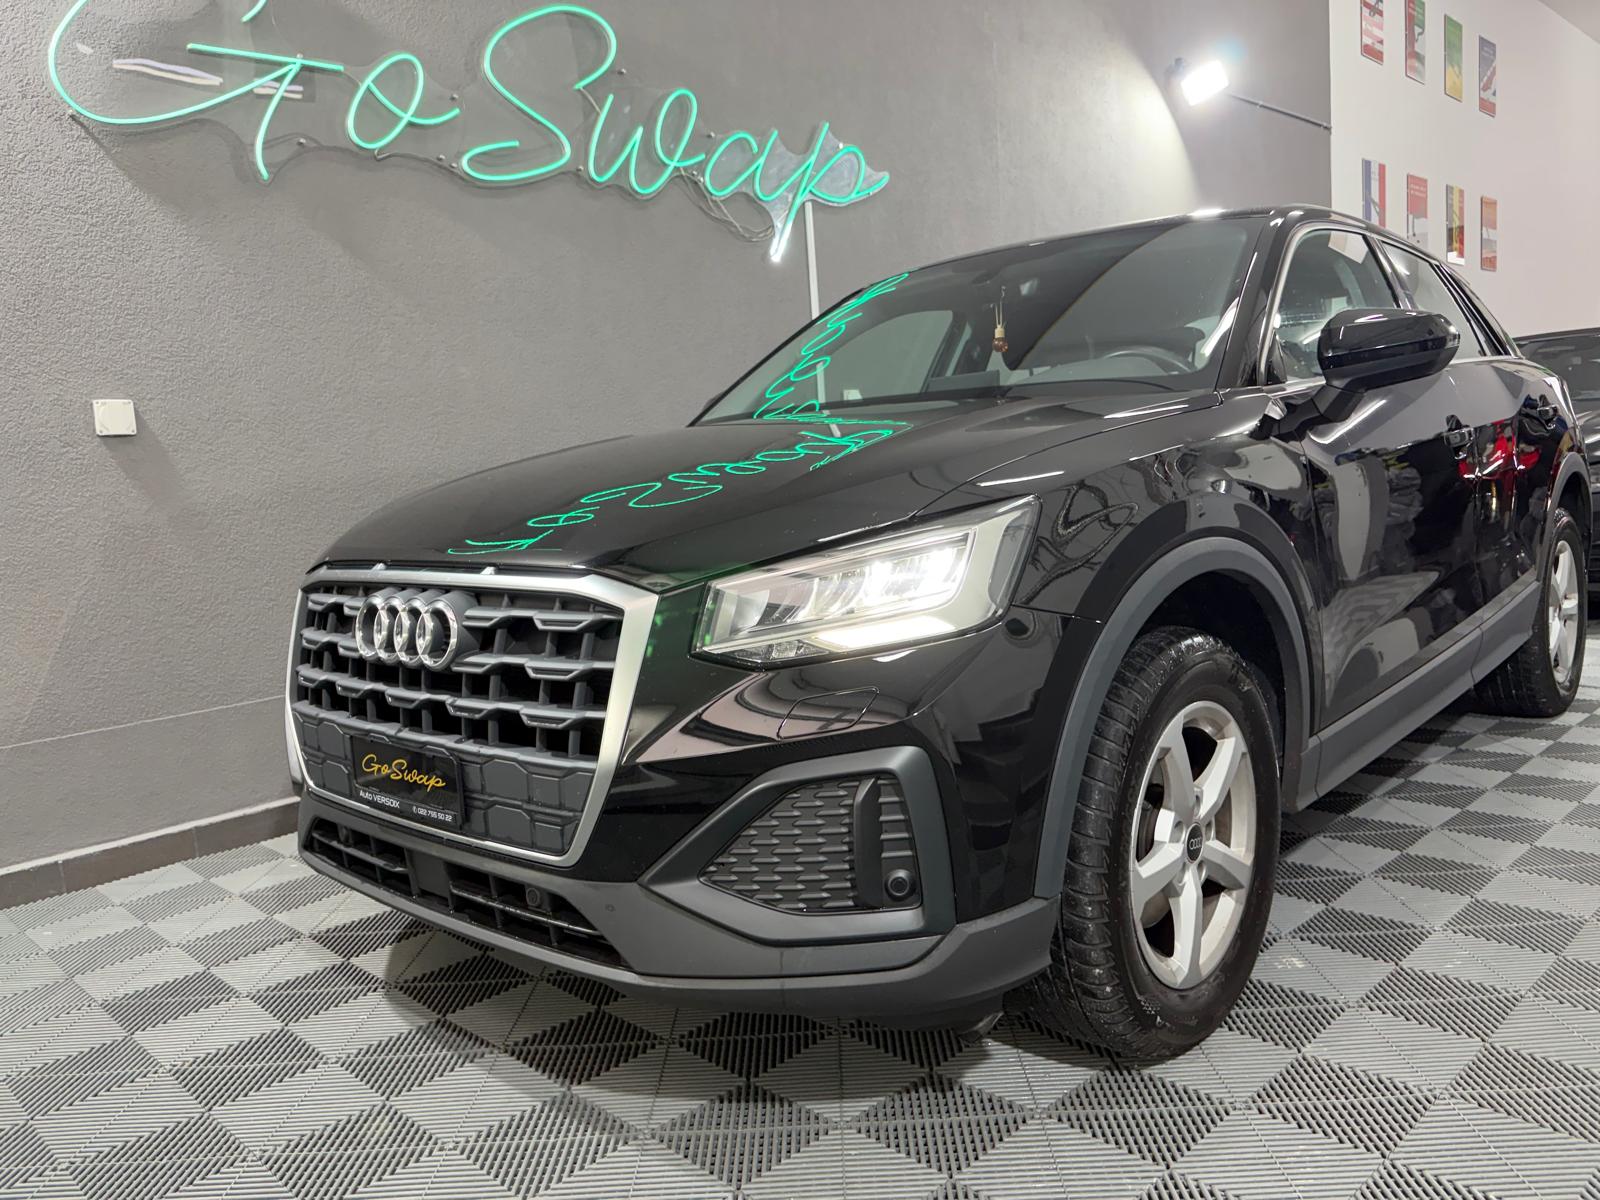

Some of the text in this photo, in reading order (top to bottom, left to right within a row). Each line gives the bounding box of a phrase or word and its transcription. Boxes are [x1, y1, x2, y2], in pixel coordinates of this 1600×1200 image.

[362, 754, 446, 792] GoSwap
[360, 790, 400, 808] Auto VERSOIX
